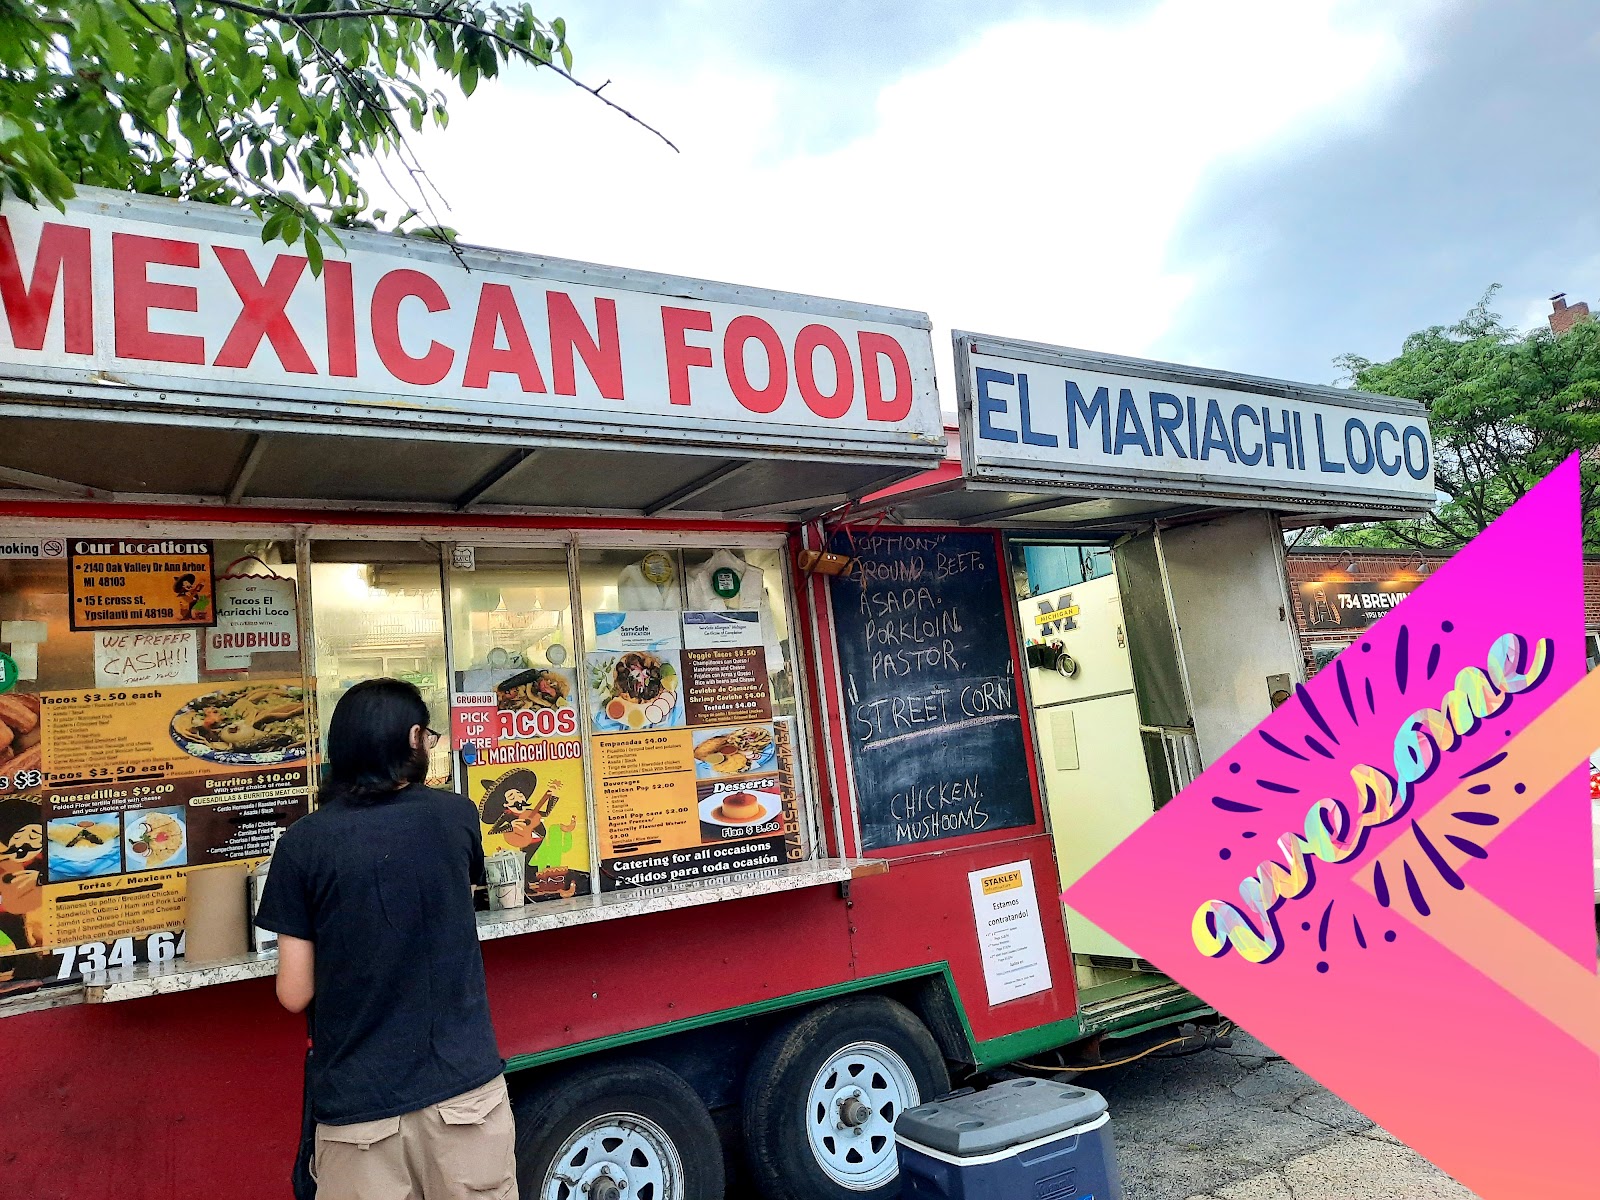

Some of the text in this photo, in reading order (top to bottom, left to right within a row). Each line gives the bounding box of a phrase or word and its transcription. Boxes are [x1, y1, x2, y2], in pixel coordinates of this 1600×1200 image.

[0, 215, 913, 422] MEXICAN FOOD
[976, 367, 1430, 481] EL MARIACHI LOCO
[75, 541, 208, 554] Our locations
[83, 563, 104, 573] 2140
[106, 563, 122, 572] Oak
[124, 563, 151, 573] Valley
[153, 562, 163, 571] Dr
[164, 562, 181, 571] Ann
[849, 555, 924, 582] GROUND
[83, 577, 125, 587] MI 48103
[84, 596, 96, 605] 15
[105, 597, 132, 605] cross
[230, 596, 273, 605] Tacos El
[1337, 593, 1361, 609] 734
[84, 608, 174, 621] Ypsilanti mi 48198
[265, 607, 289, 617] Loco
[1036, 592, 1078, 637] M
[1040, 609, 1074, 623] MICHIGAN
[103, 632, 191, 648] WE PREFER
[212, 632, 291, 650] GRUBHUB
[103, 647, 188, 675] CASH!!!
[40, 690, 162, 705] Tacos $3.50 each
[456, 696, 492, 704] GRUBHUB
[459, 711, 490, 723] PICK
[465, 722, 485, 736] UP
[549, 740, 582, 760] LOCO
[600, 739, 642, 748] Empanadas
[42, 770, 82, 781] Tacos
[89, 766, 136, 778] $3.50
[141, 762, 174, 772] each
[205, 771, 301, 789] Burritos $10.00
[652, 782, 675, 790] $2.00
[713, 778, 775, 794] Desserts
[50, 783, 175, 804] Quesadillas $9.00
[193, 795, 237, 805] QUESADILLAS
[243, 790, 274, 800] BURRITOS
[274, 789, 291, 797] MEAT
[665, 807, 689, 815] $2.00
[896, 801, 989, 842] MUSHOOMS
[721, 827, 744, 838] Flan
[745, 825, 753, 836] $
[613, 841, 772, 872] Catering for all occasions
[670, 864, 700, 881] para
[702, 860, 730, 874] toda
[732, 854, 779, 871] ocasión
[78, 881, 112, 891] Tortas
[127, 874, 172, 885] Mexican
[983, 873, 1019, 887] STANLEY
[152, 889, 179, 898] Chicken
[56, 911, 91, 920] Sandwich
[155, 898, 171, 906] Pork
[992, 898, 1019, 911] Estamos
[124, 910, 140, 918] Ham
[988, 908, 1029, 927] contratando!
[56, 918, 145, 937] Tinga Shredded Chicken
[107, 929, 130, 937] Queso
[53, 937, 137, 980] 734
